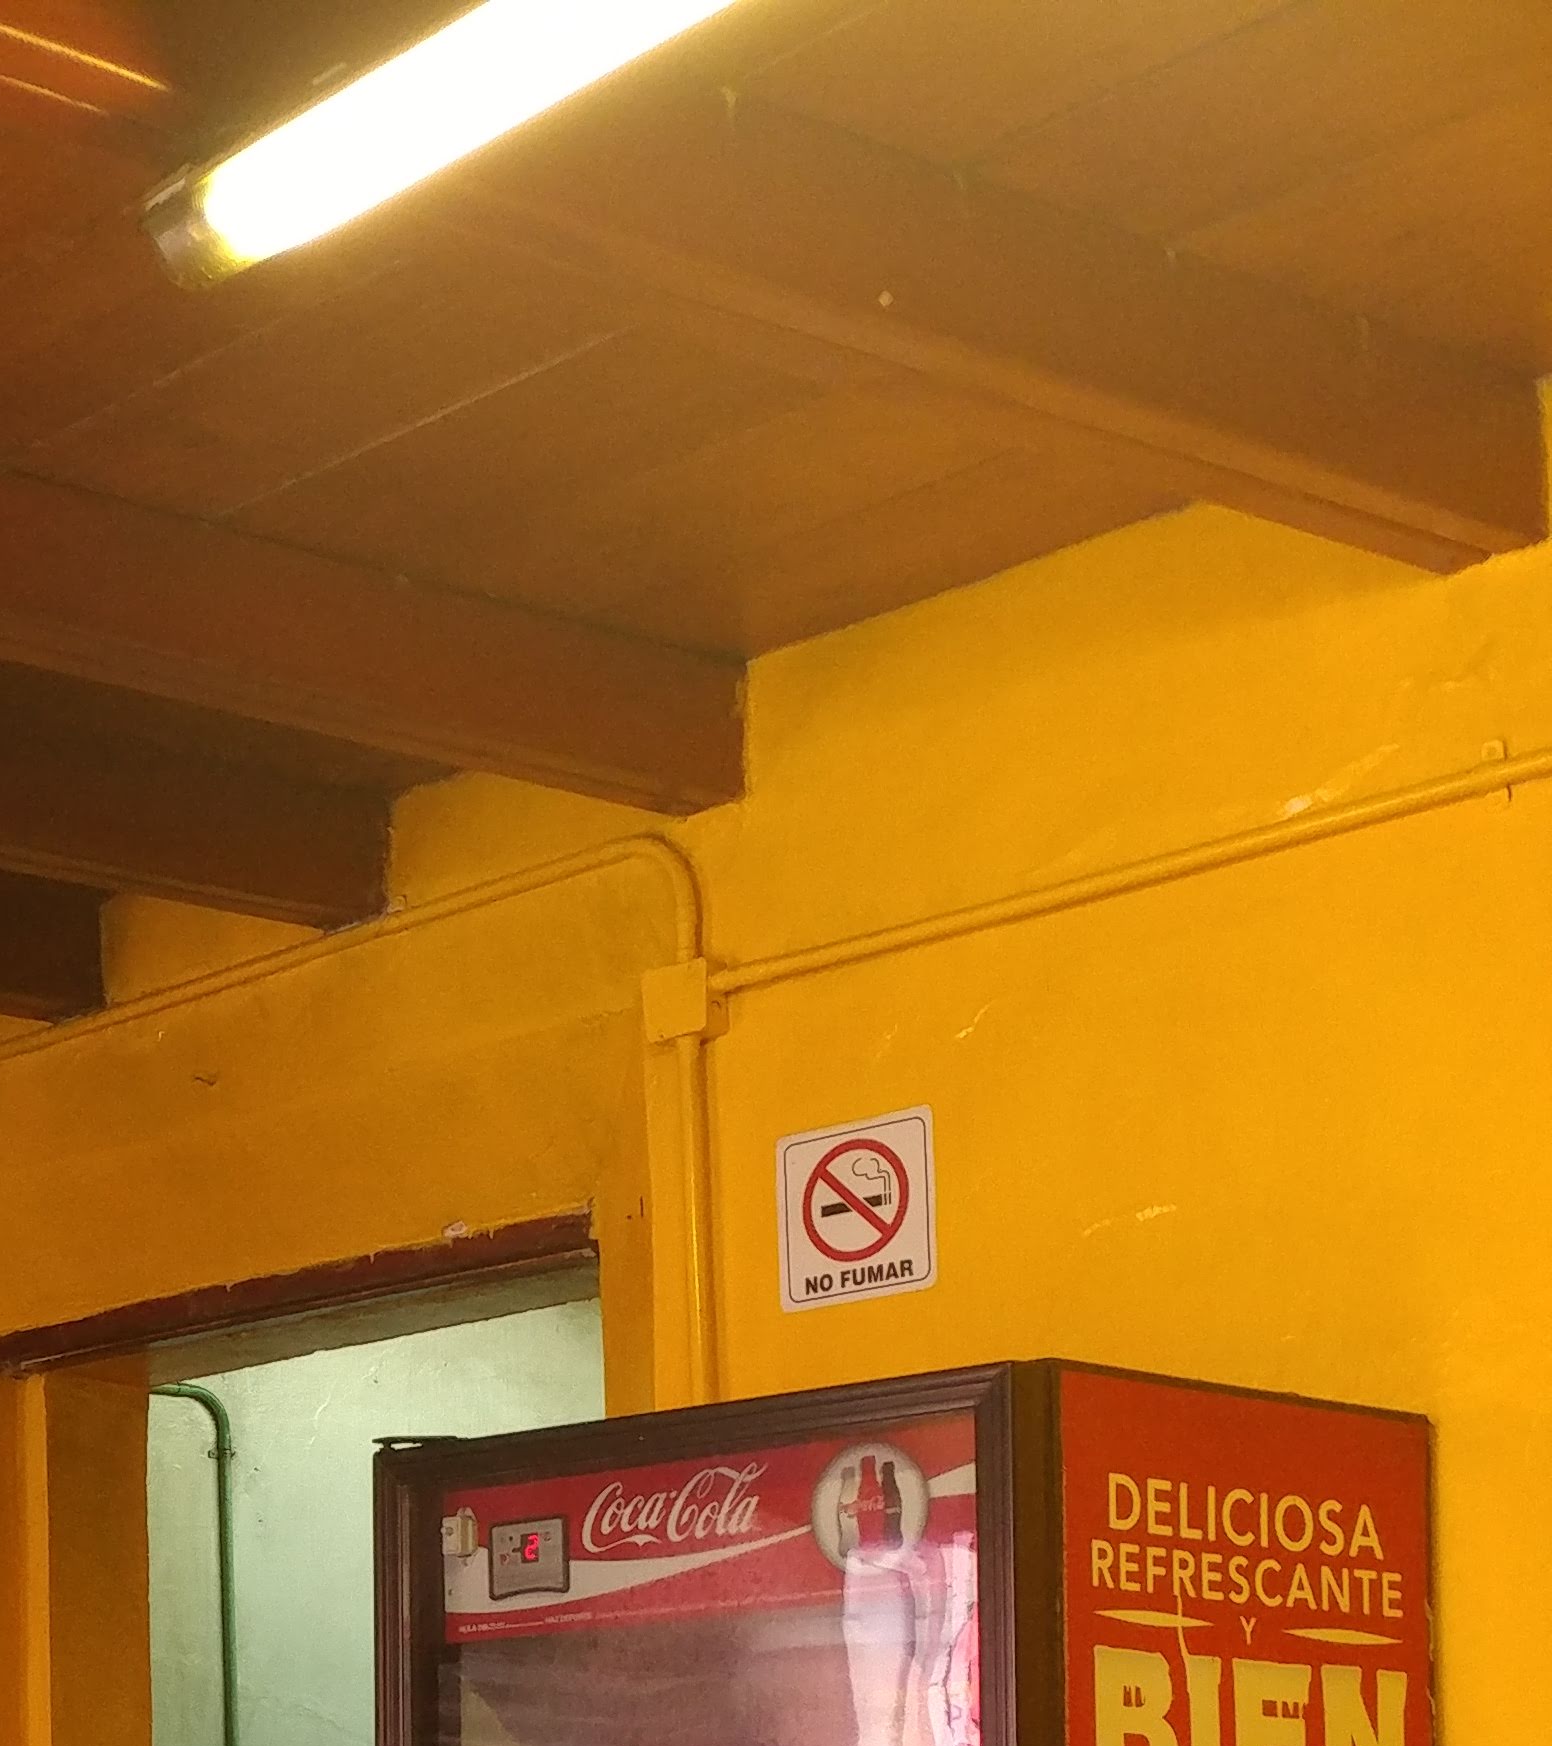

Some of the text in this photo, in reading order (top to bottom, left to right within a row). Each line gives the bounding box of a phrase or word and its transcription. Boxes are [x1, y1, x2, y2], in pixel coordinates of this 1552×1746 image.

[804, 1258, 915, 1296] NO FUMAR
[1107, 1472, 1385, 1561] DELICIOSA
[1090, 1538, 1404, 1618] REFRESCANTE
[1239, 1616, 1257, 1645] Y
